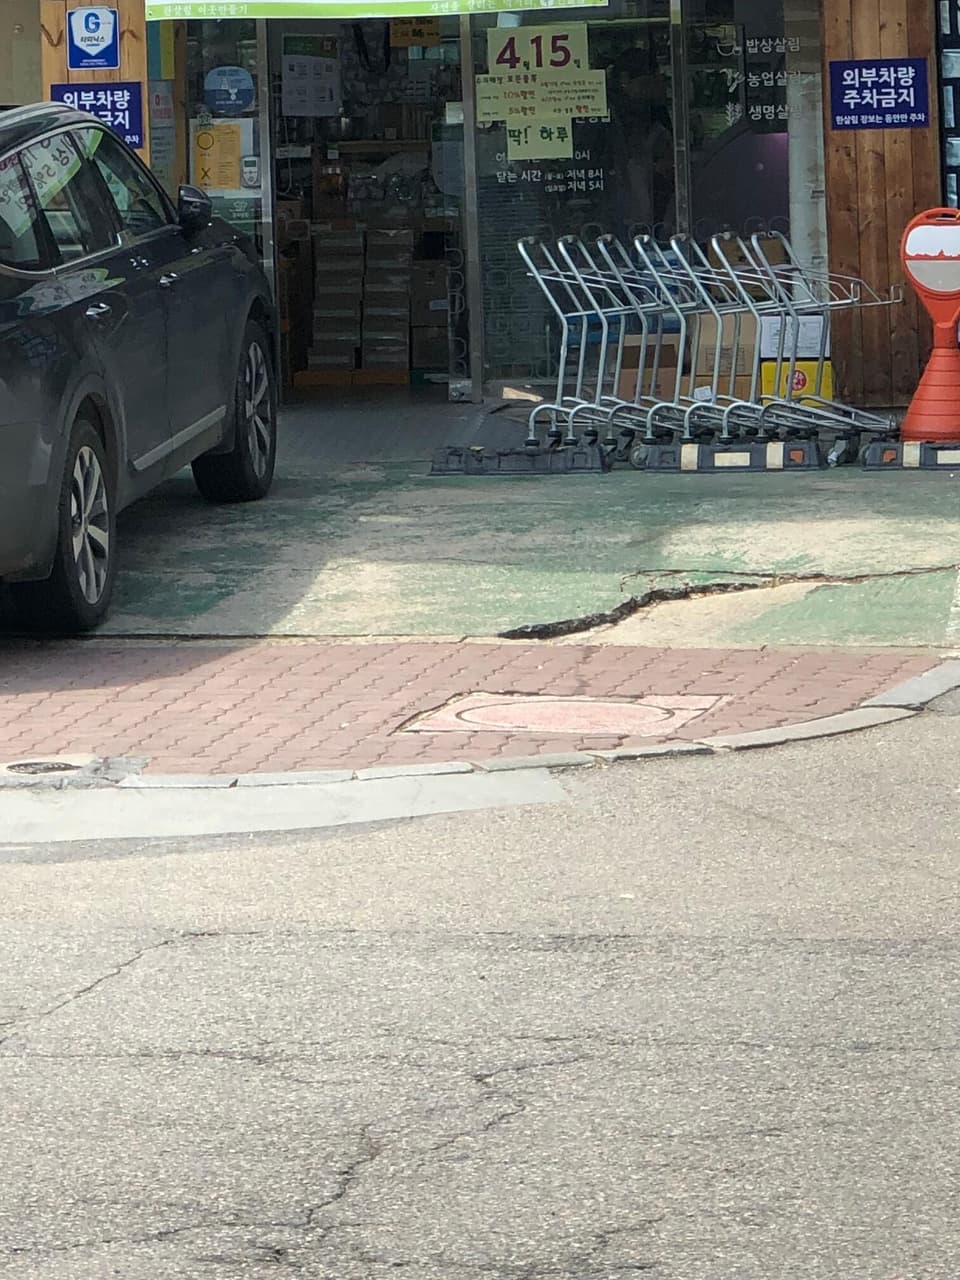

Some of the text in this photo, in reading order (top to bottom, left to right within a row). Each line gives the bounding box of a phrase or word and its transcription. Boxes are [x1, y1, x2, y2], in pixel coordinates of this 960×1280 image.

[745, 37, 800, 54] 밥상살림
[842, 66, 916, 88] 외부차량
[63, 89, 131, 110] 외부차량
[843, 87, 915, 110] 주차금지
[835, 115, 859, 126] 한살림
[860, 114, 883, 124] 장보는
[909, 113, 926, 123] 주차
[539, 126, 569, 142] 하루
[496, 170, 518, 184] 닫는
[521, 169, 542, 182] 시간
[567, 169, 586, 180] 저녁
[588, 168, 603, 179] 8시
[567, 180, 587, 192] 저녁
[588, 180, 604, 191] 5시
